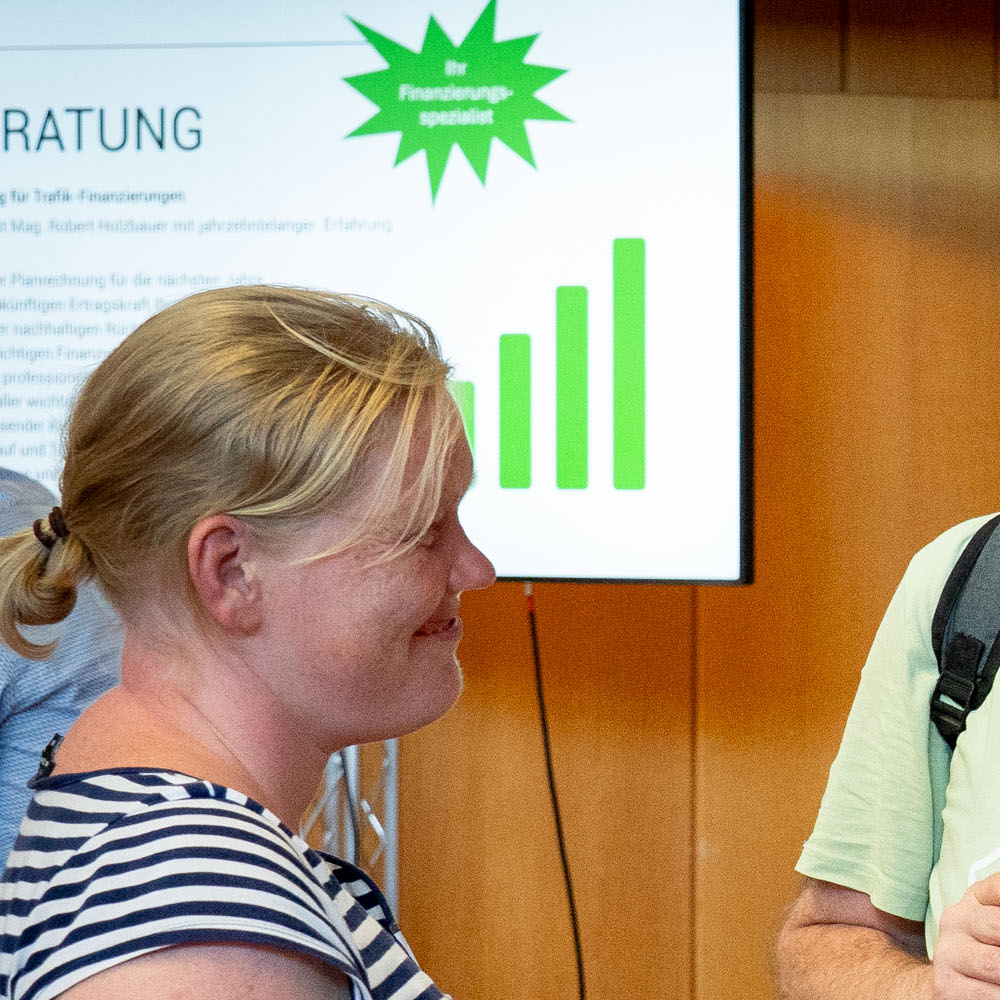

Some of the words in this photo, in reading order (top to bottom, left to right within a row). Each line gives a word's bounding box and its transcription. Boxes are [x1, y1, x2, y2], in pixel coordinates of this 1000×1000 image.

[399, 84, 514, 104] Finanzierungs-
[419, 108, 494, 127] spezialist
[3, 106, 202, 152] RATUNG
